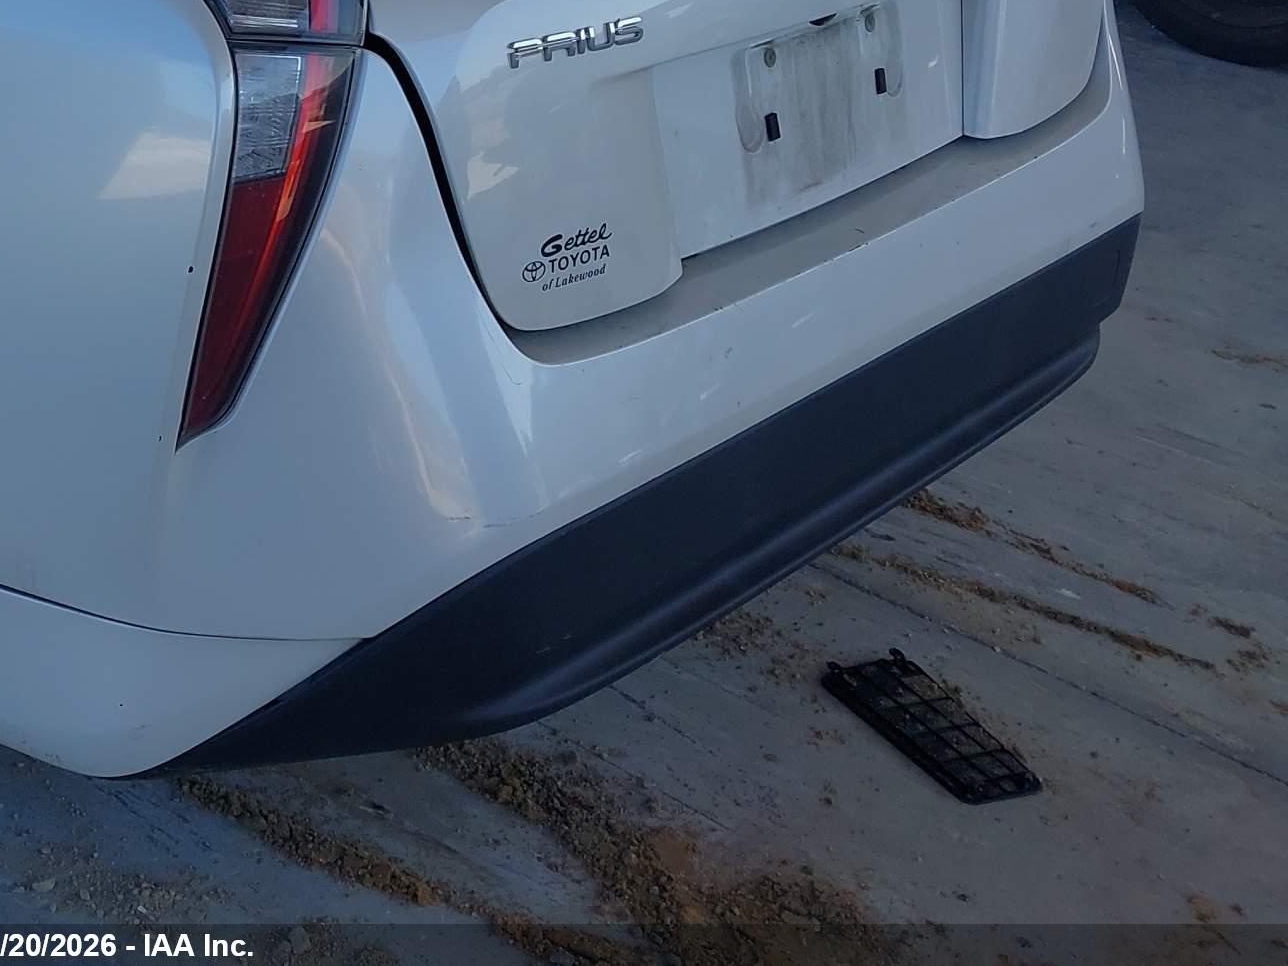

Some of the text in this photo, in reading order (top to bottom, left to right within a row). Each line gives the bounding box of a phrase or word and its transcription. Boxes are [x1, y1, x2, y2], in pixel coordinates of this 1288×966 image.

[507, 16, 643, 69] PRIUS
[540, 222, 613, 258] Gettel
[548, 244, 610, 274] TOYOTA
[542, 263, 606, 292] of Lakewood
